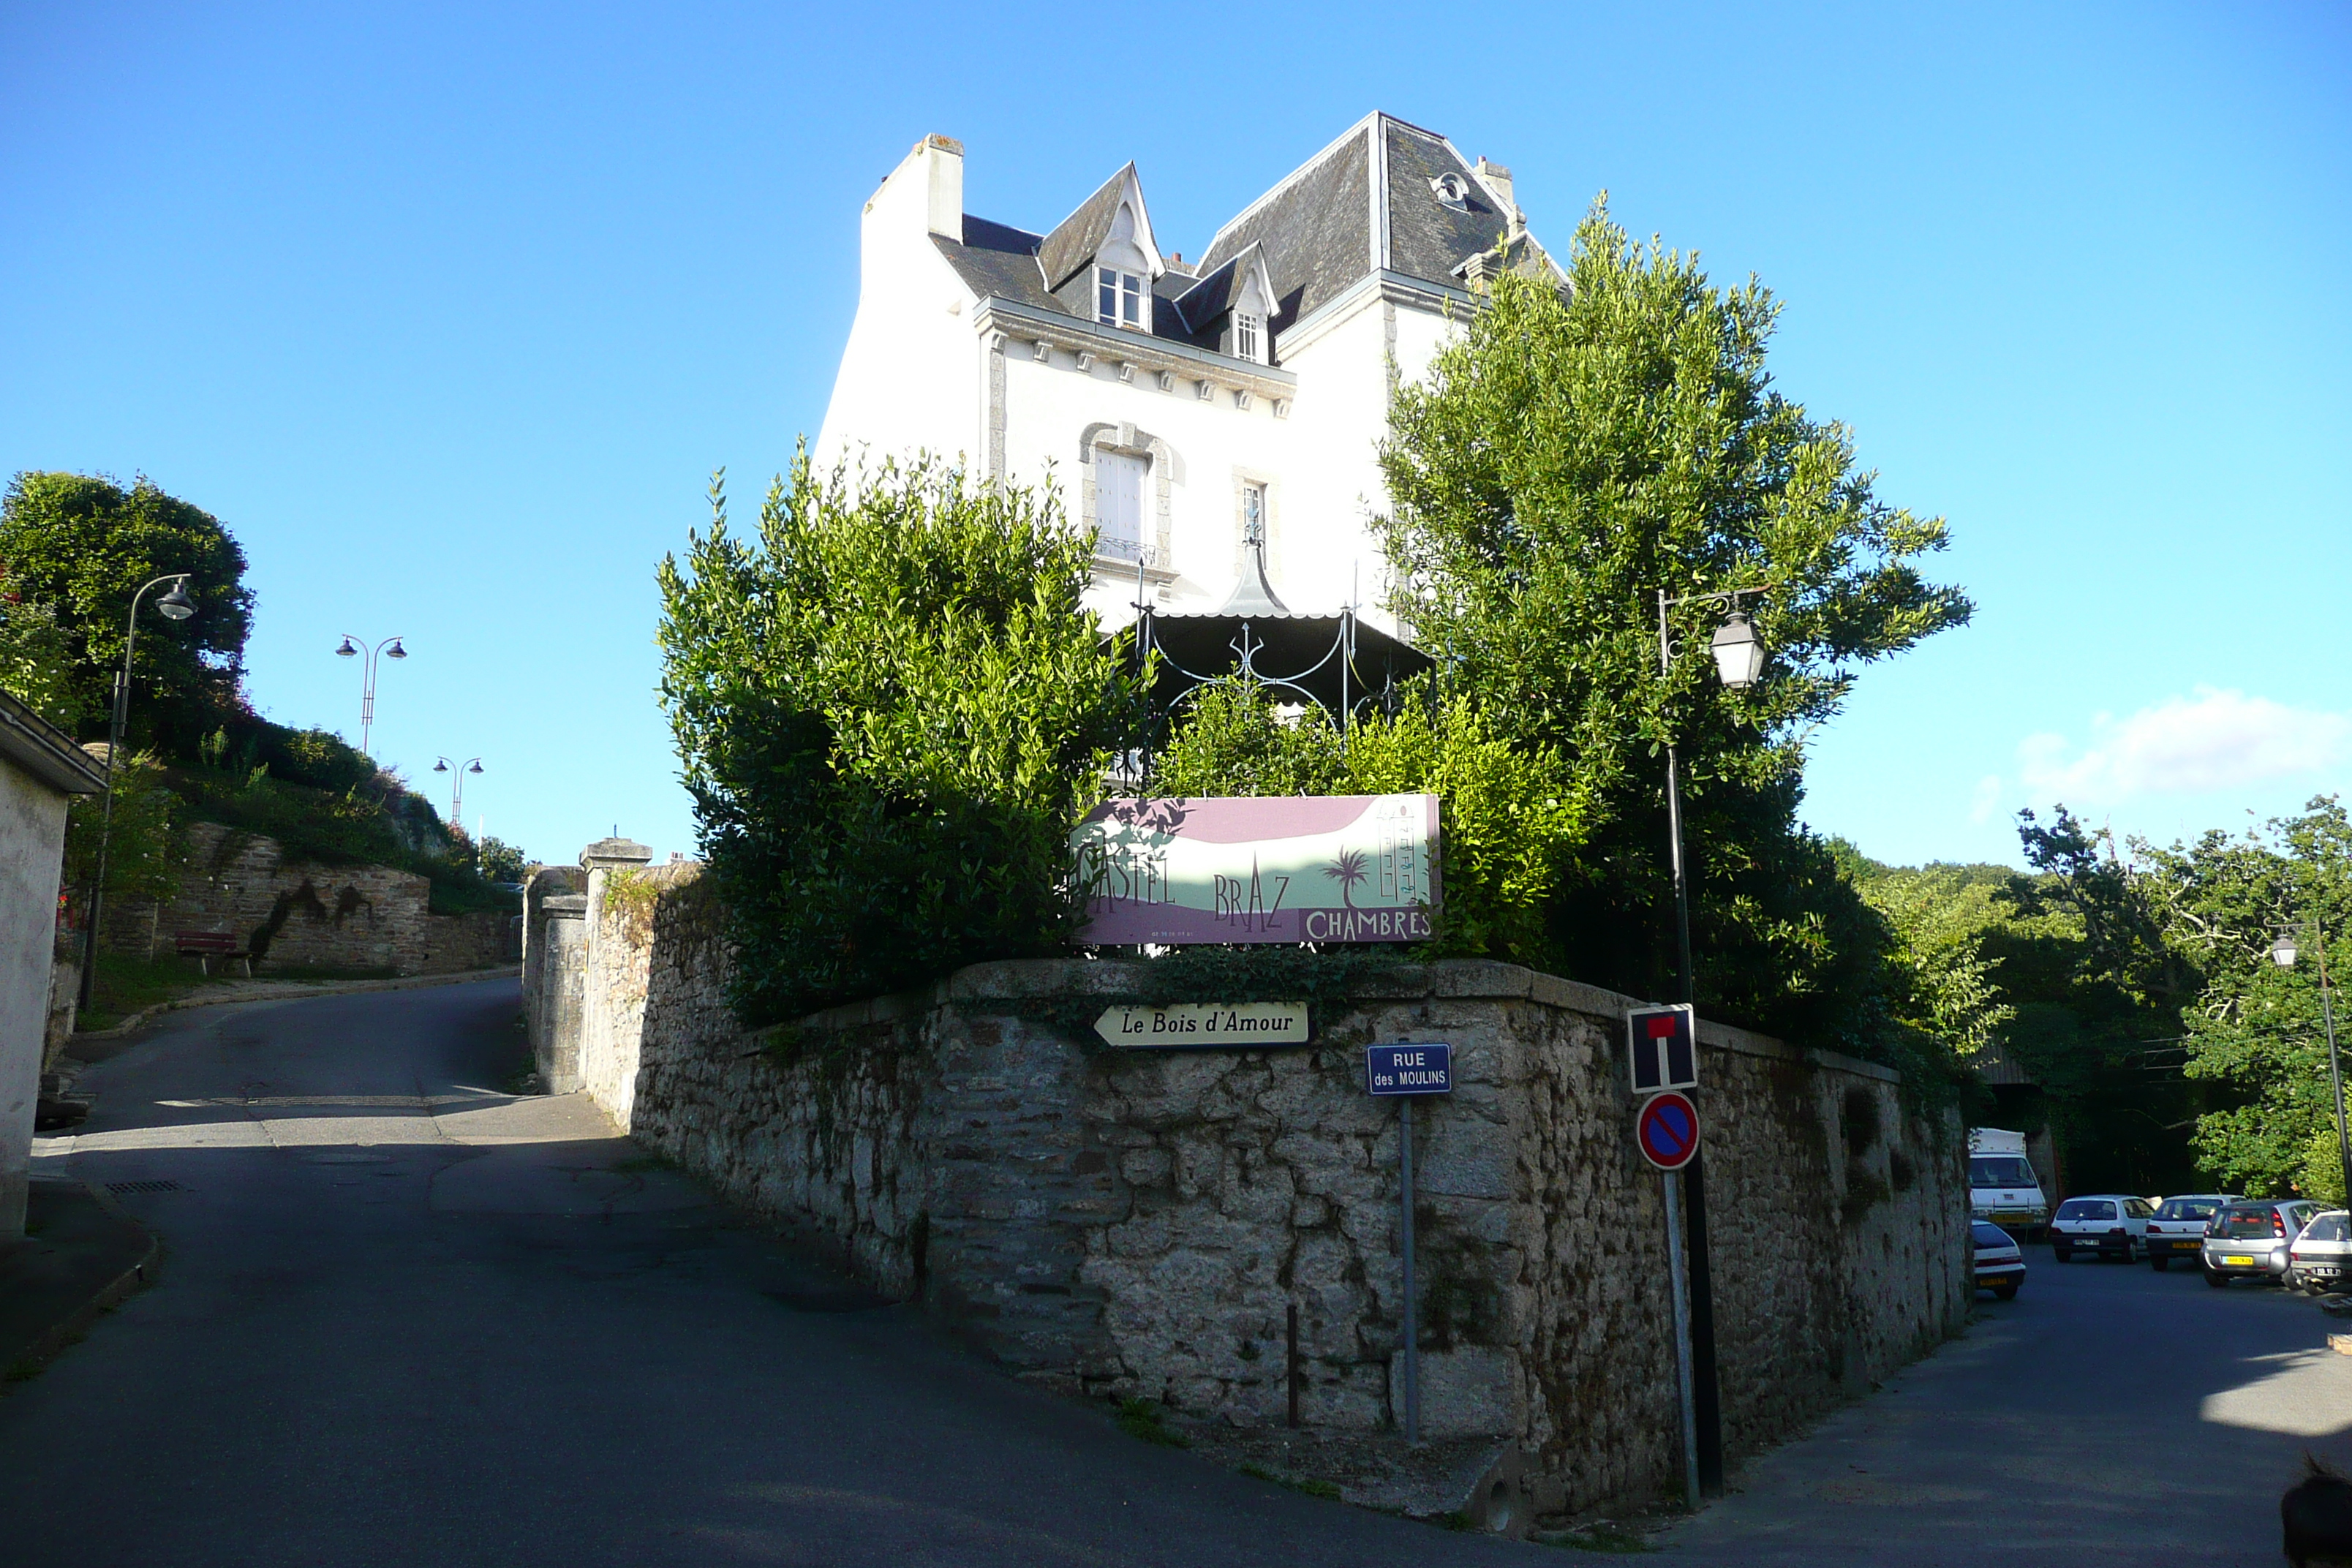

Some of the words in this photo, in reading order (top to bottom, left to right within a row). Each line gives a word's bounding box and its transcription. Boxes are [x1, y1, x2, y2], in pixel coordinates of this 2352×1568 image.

[1076, 829, 1176, 914] CASTEL
[1213, 848, 1290, 933] BRAZ
[1306, 911, 1432, 941] CHAMBRES
[1122, 1012, 1144, 1034] Le
[1152, 1012, 1196, 1033] Bois
[1205, 1011, 1294, 1033] d'Amour
[1393, 1052, 1426, 1067] RUE
[1374, 1073, 1394, 1087] des
[1399, 1069, 1446, 1086] MOULINS
